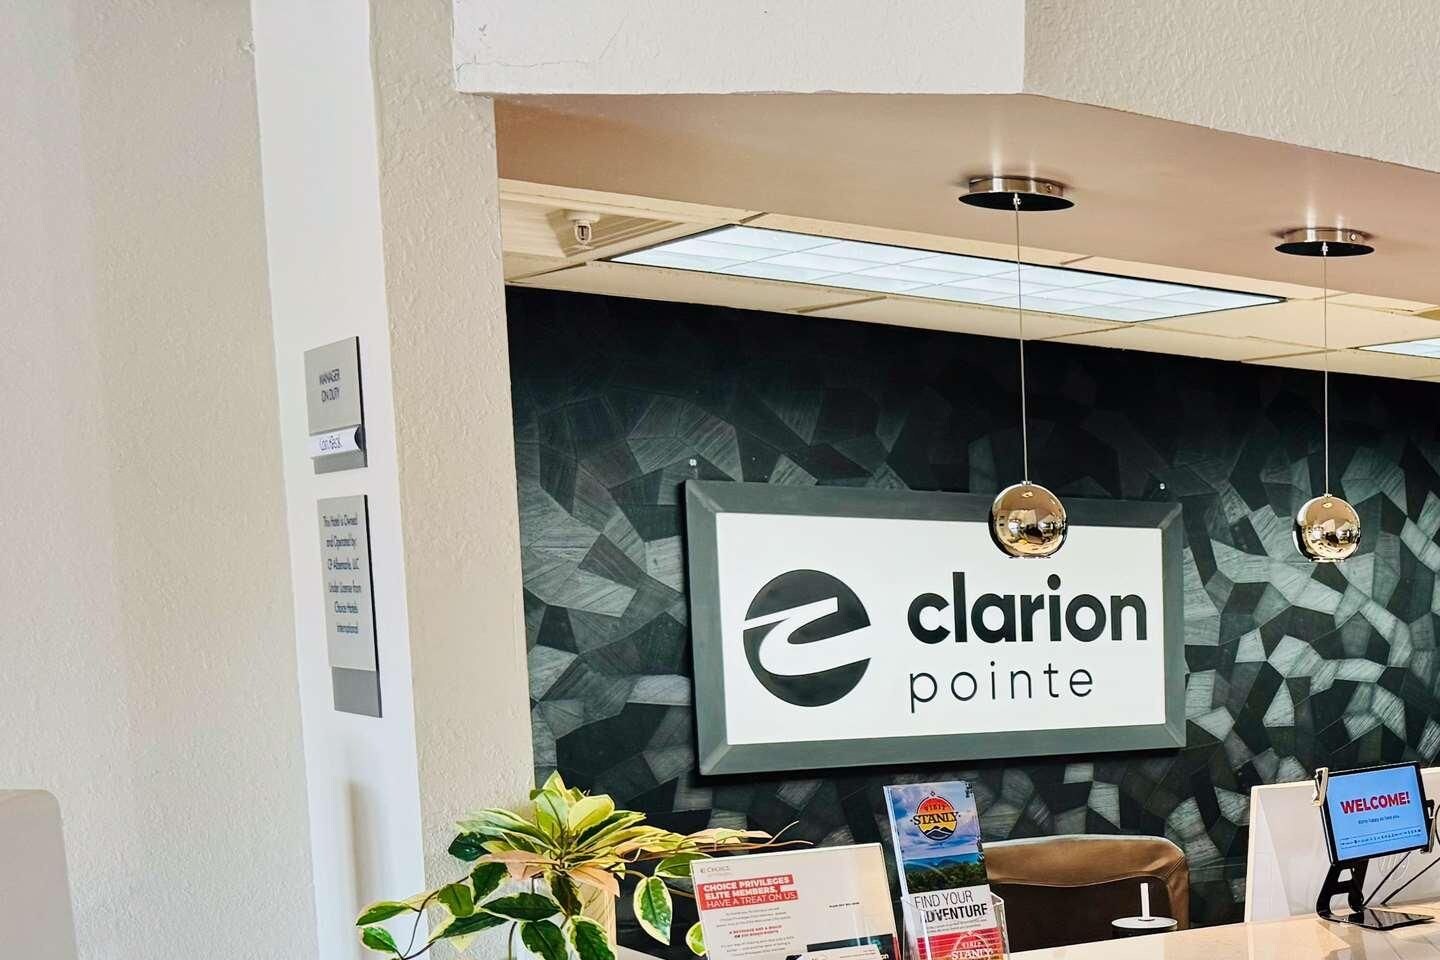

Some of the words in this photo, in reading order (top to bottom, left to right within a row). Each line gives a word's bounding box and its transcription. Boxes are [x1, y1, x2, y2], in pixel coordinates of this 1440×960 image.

[907, 571, 1148, 644] clarion
[909, 660, 1094, 714] pointe
[1340, 791, 1411, 815] WELCOME!
[912, 811, 959, 826] STANLY
[703, 881, 738, 893] CHOICE
[738, 876, 790, 890] PRIVILEGES
[704, 890, 731, 901] ELITE
[706, 899, 732, 909] HAVE
[733, 898, 740, 906] A
[741, 894, 767, 905] TREAT
[768, 893, 781, 901] ON
[784, 891, 796, 900] US
[914, 895, 940, 910] FIND
[941, 890, 974, 906] YOUR
